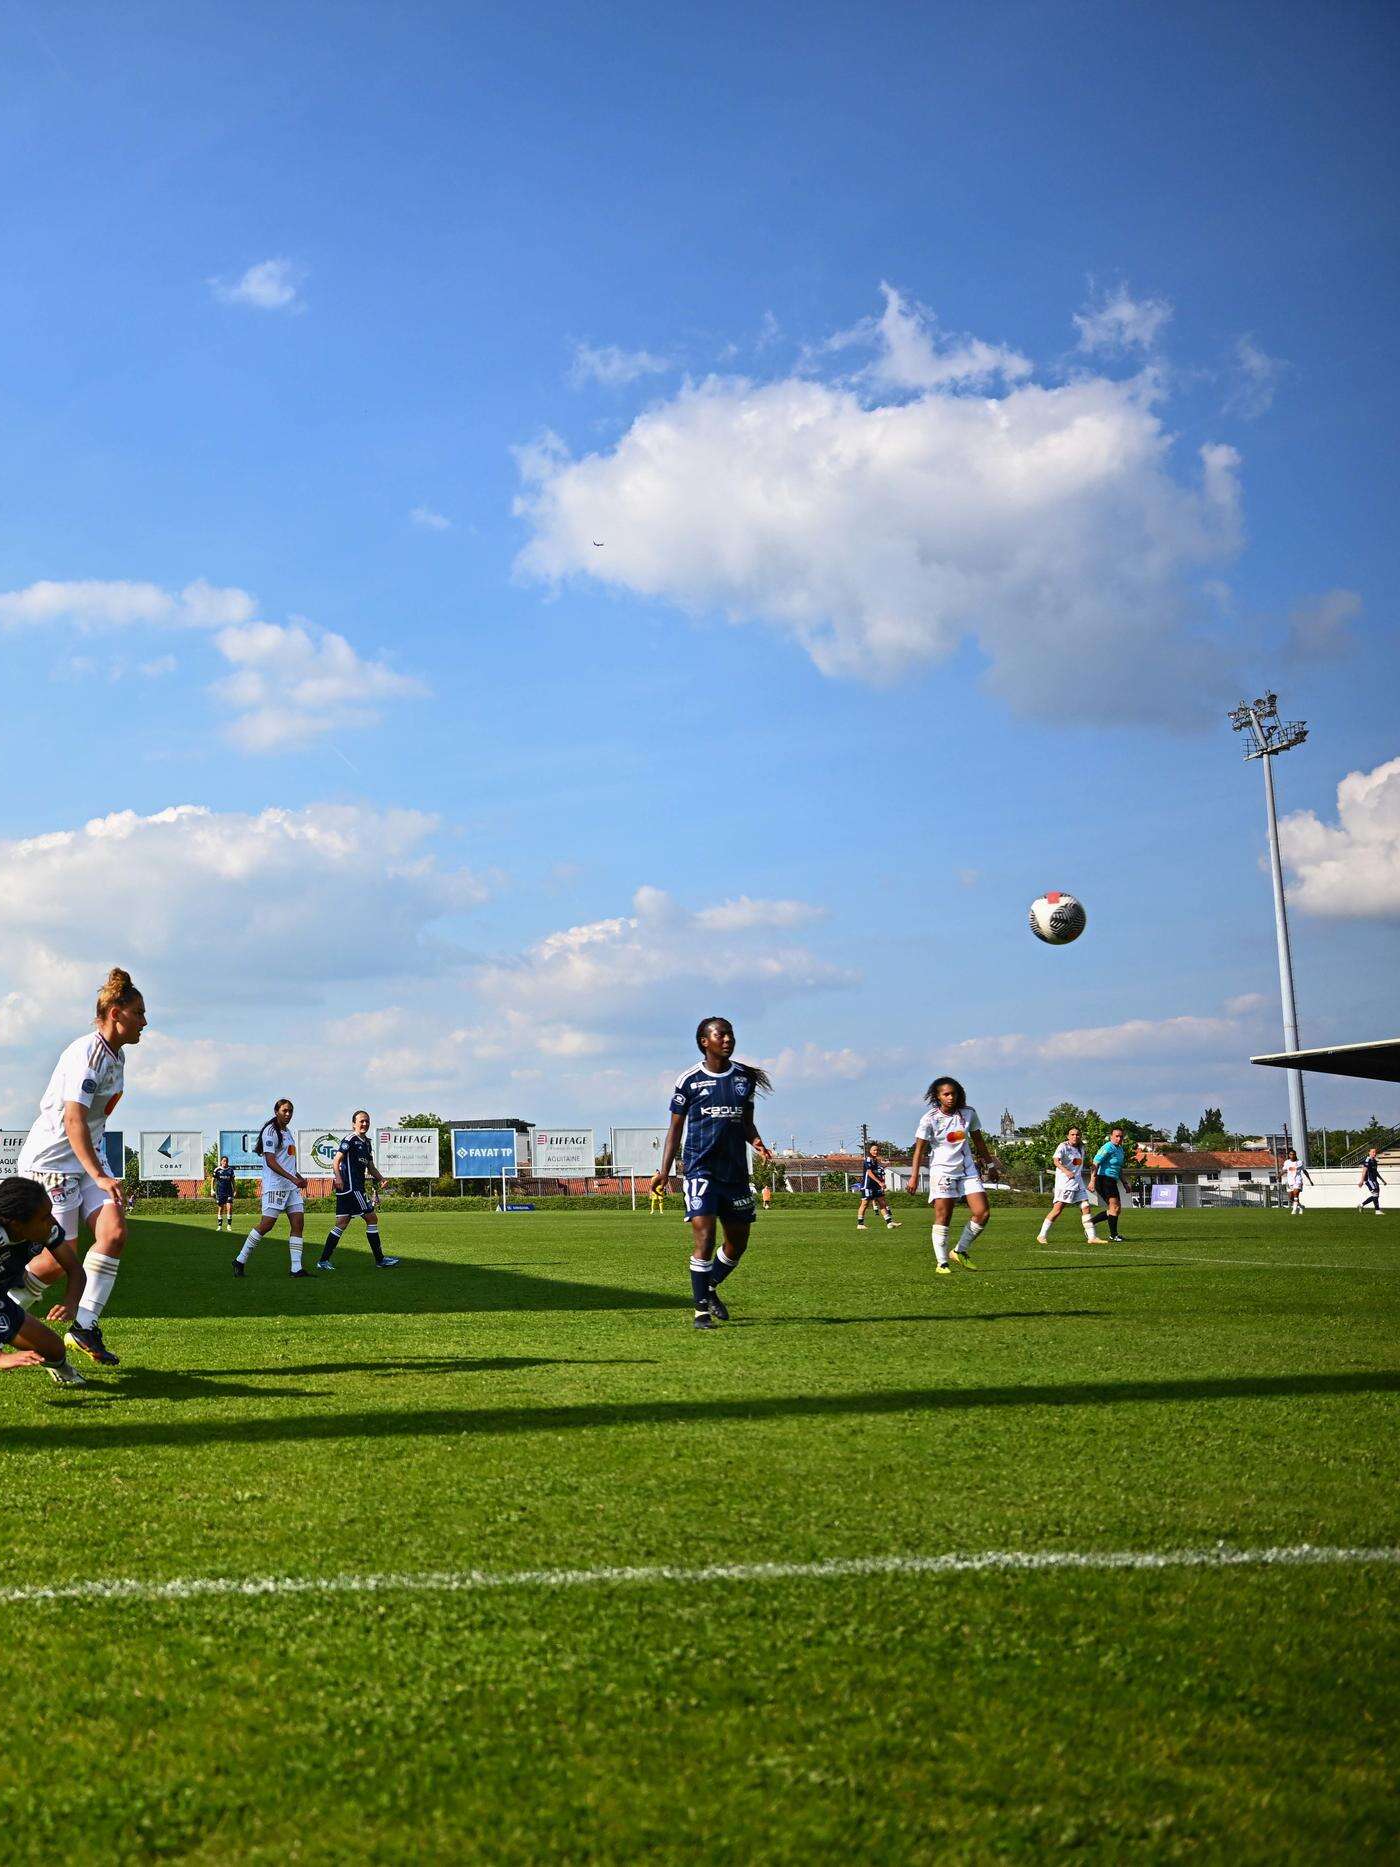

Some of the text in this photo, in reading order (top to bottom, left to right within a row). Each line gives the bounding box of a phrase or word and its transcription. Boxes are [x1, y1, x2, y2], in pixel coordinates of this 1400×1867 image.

[3, 1138, 24, 1146] EIFF
[393, 1135, 433, 1144] EIFFAGE
[550, 1136, 588, 1145] EIFFAGE
[469, 1148, 512, 1157] FAYAT TP
[690, 1178, 709, 1197] 17
